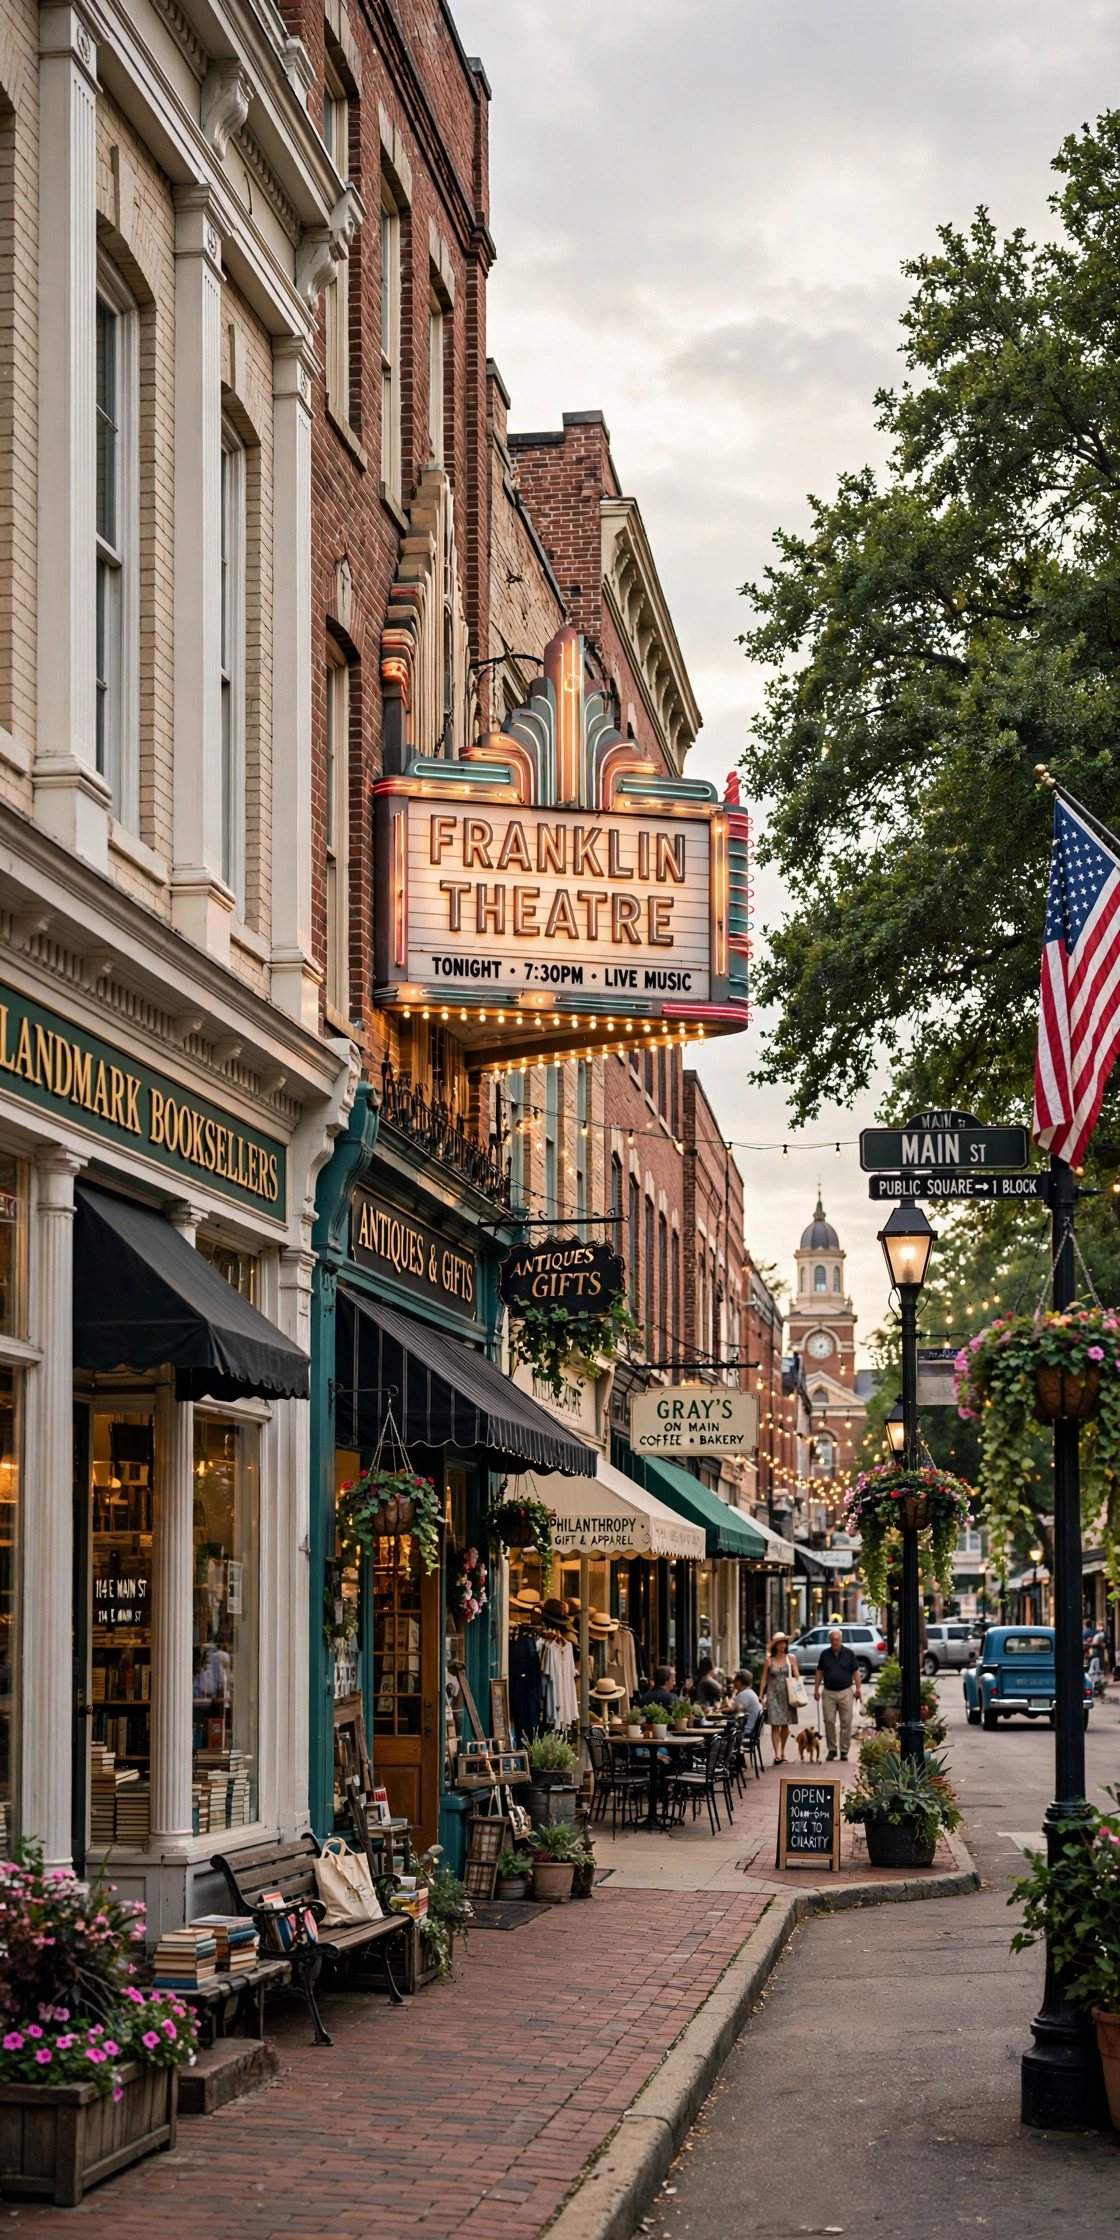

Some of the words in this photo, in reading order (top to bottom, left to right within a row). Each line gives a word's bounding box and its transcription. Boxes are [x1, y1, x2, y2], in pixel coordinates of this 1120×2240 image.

[430, 814, 686, 883] FRANKLIN
[439, 880, 674, 946] THEATRE
[432, 957, 502, 979] TONIGHT
[524, 963, 583, 984] 7:30PM
[605, 968, 637, 988] LIVE
[644, 971, 692, 991] MUSIC
[0, 1005, 142, 1135] LANDMARK
[149, 1087, 279, 1202] BOOKSELLERS
[902, 1134, 959, 1164] MAIN
[970, 1144, 986, 1162] ST
[879, 1179, 921, 1195] PUBLIC
[927, 1179, 974, 1195] SQUARE
[993, 1180, 997, 1194] 1
[1003, 1179, 1037, 1194] BLOCK
[358, 1202, 424, 1277] ANTIQUES
[429, 1244, 438, 1284] &
[442, 1250, 473, 1302] GIFTS
[510, 1248, 595, 1278] ANTIQUES
[532, 1272, 602, 1298] GIFTS
[657, 1400, 733, 1419] GRAY'S
[664, 1422, 682, 1432] ON
[689, 1422, 720, 1432] MAIN
[639, 1434, 682, 1447] COFFEE
[700, 1435, 744, 1445] BAKERY
[550, 1518, 636, 1533] PHILANTHROPY
[555, 1535, 576, 1545] GIFT
[580, 1535, 586, 1545] &
[591, 1535, 633, 1546] APPAREL
[109, 1579, 115, 1598] E
[138, 1578, 147, 1598] ST
[792, 1788, 825, 1804] OPEN
[811, 1821, 823, 1833] TO
